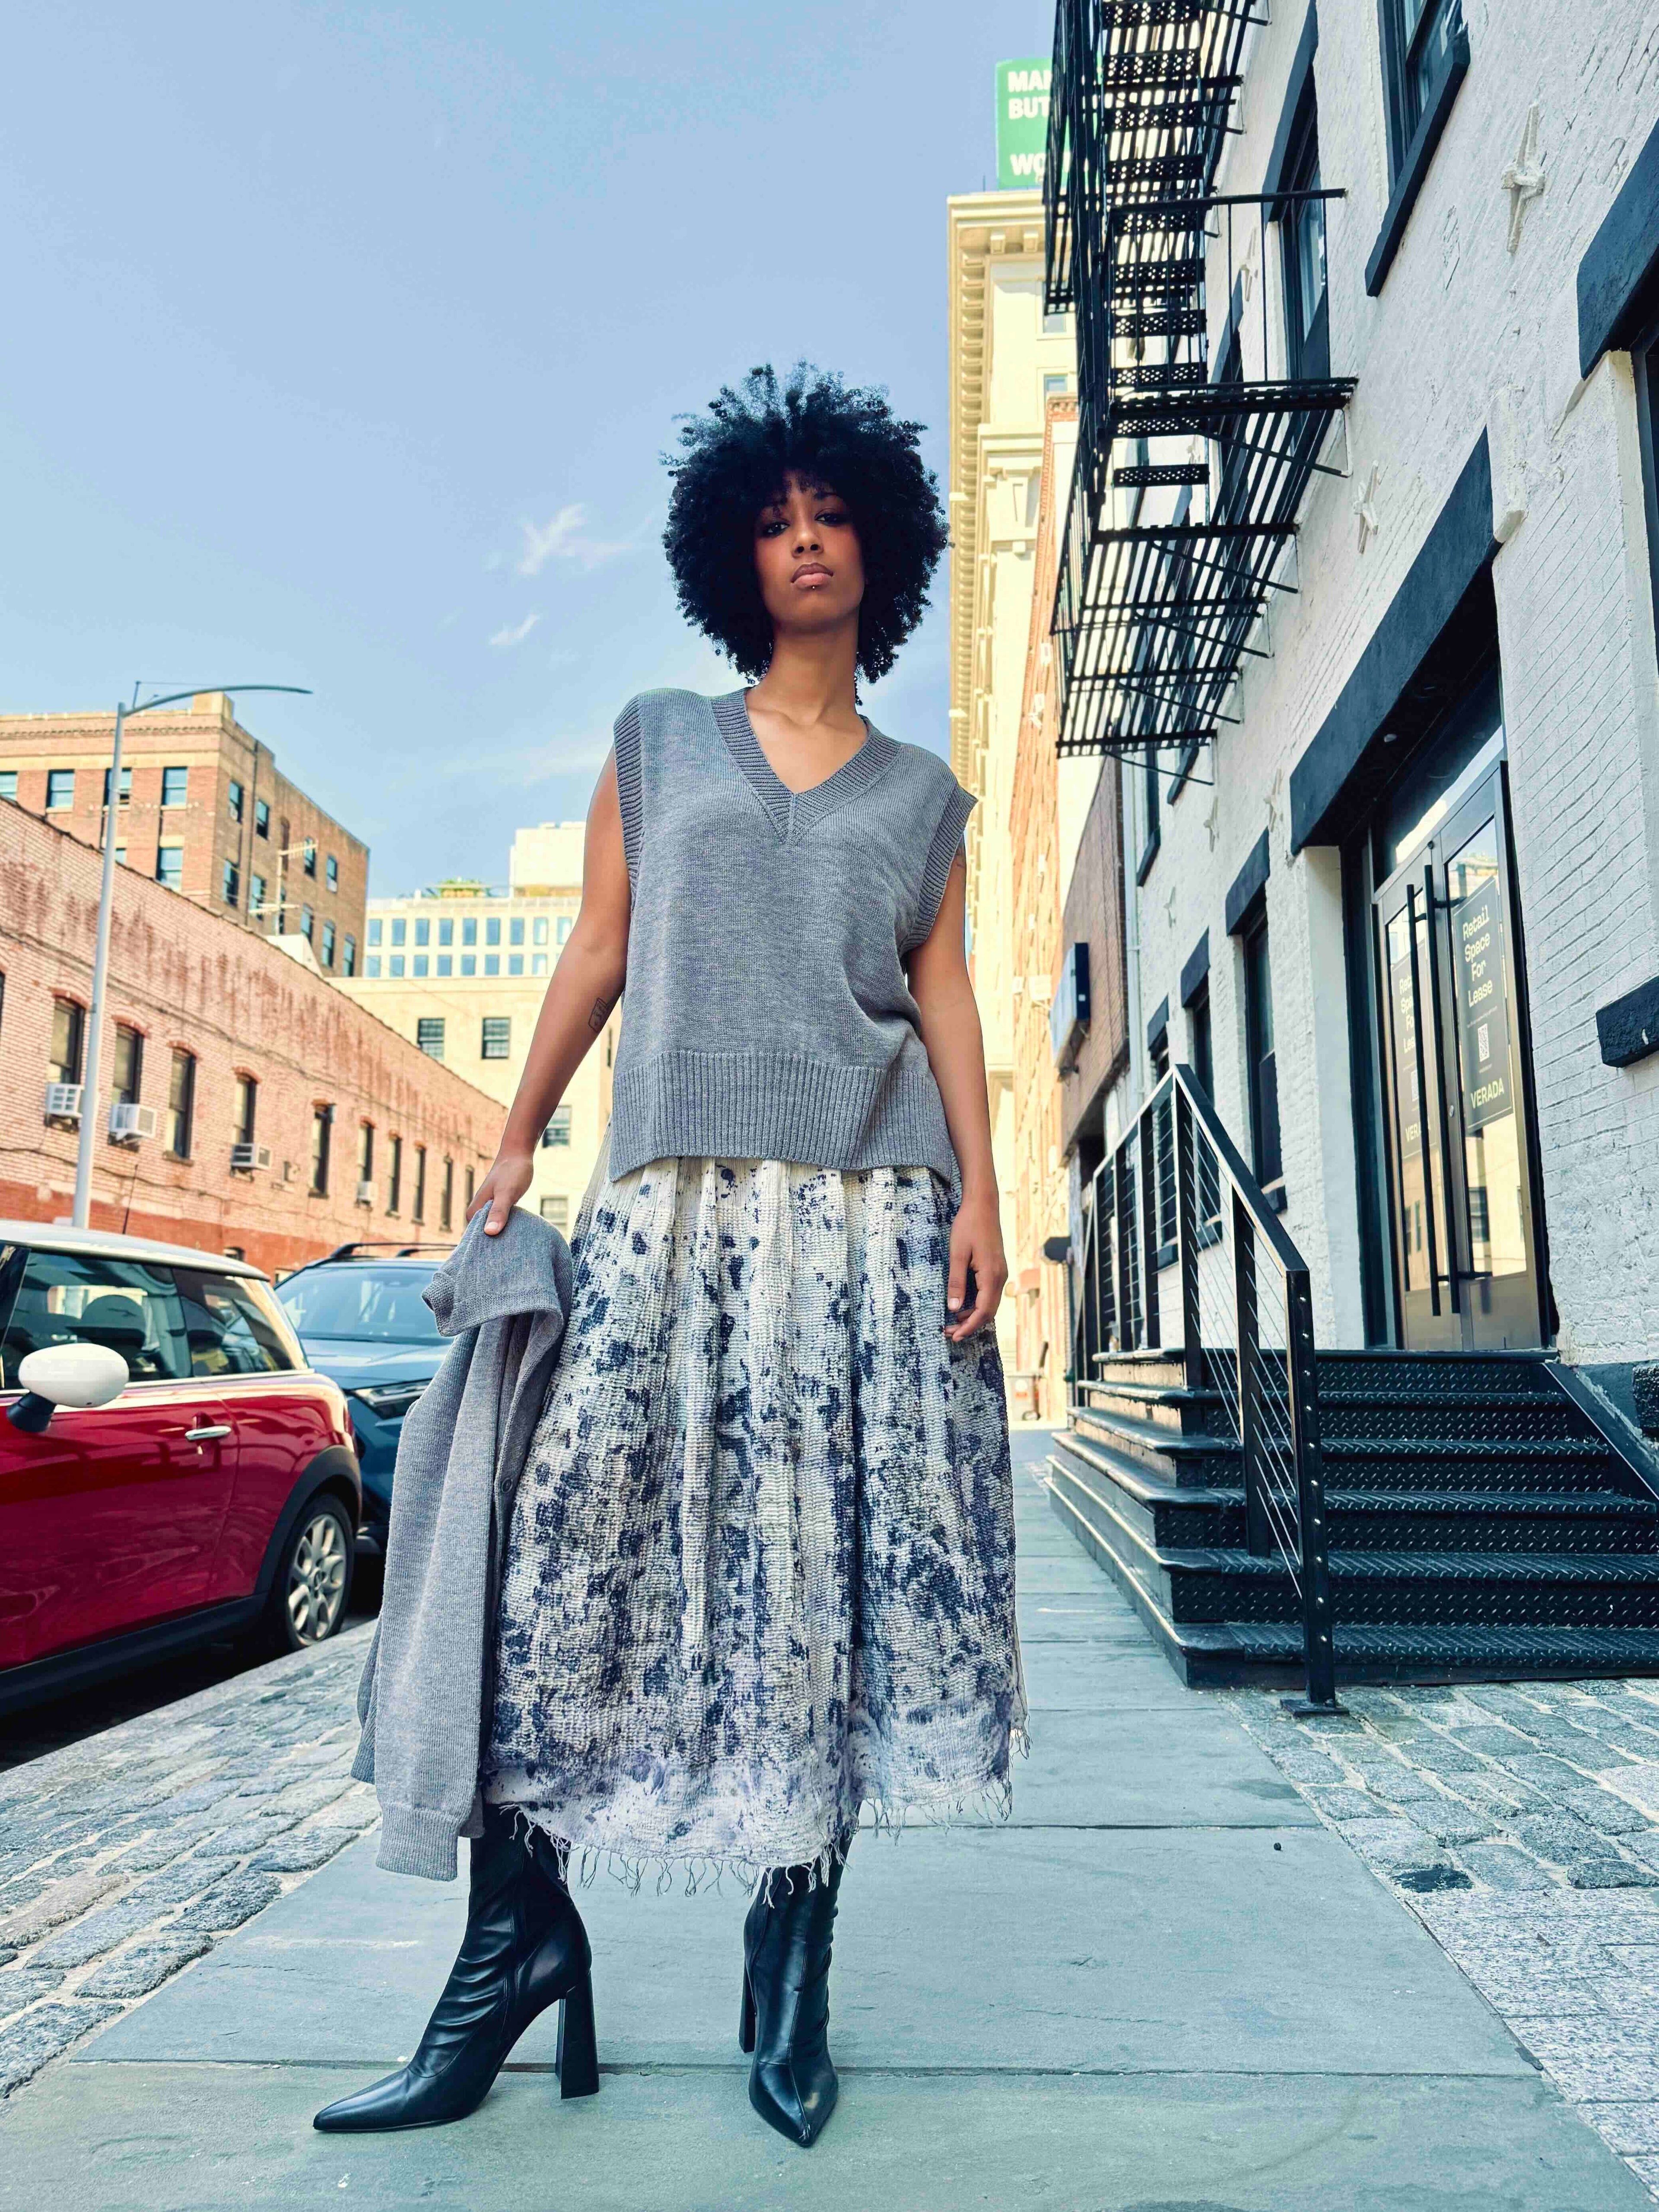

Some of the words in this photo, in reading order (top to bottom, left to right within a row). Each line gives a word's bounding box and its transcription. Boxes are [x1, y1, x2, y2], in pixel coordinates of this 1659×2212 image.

[1463, 905, 1489, 941] Retail
[1465, 933, 1491, 962] Space
[1471, 959, 1486, 981] For
[1401, 996, 1413, 1014] Spa
[1468, 980, 1493, 1007] Lease
[1404, 1036, 1415, 1054] Lea
[1471, 1078, 1504, 1108] VERADA
